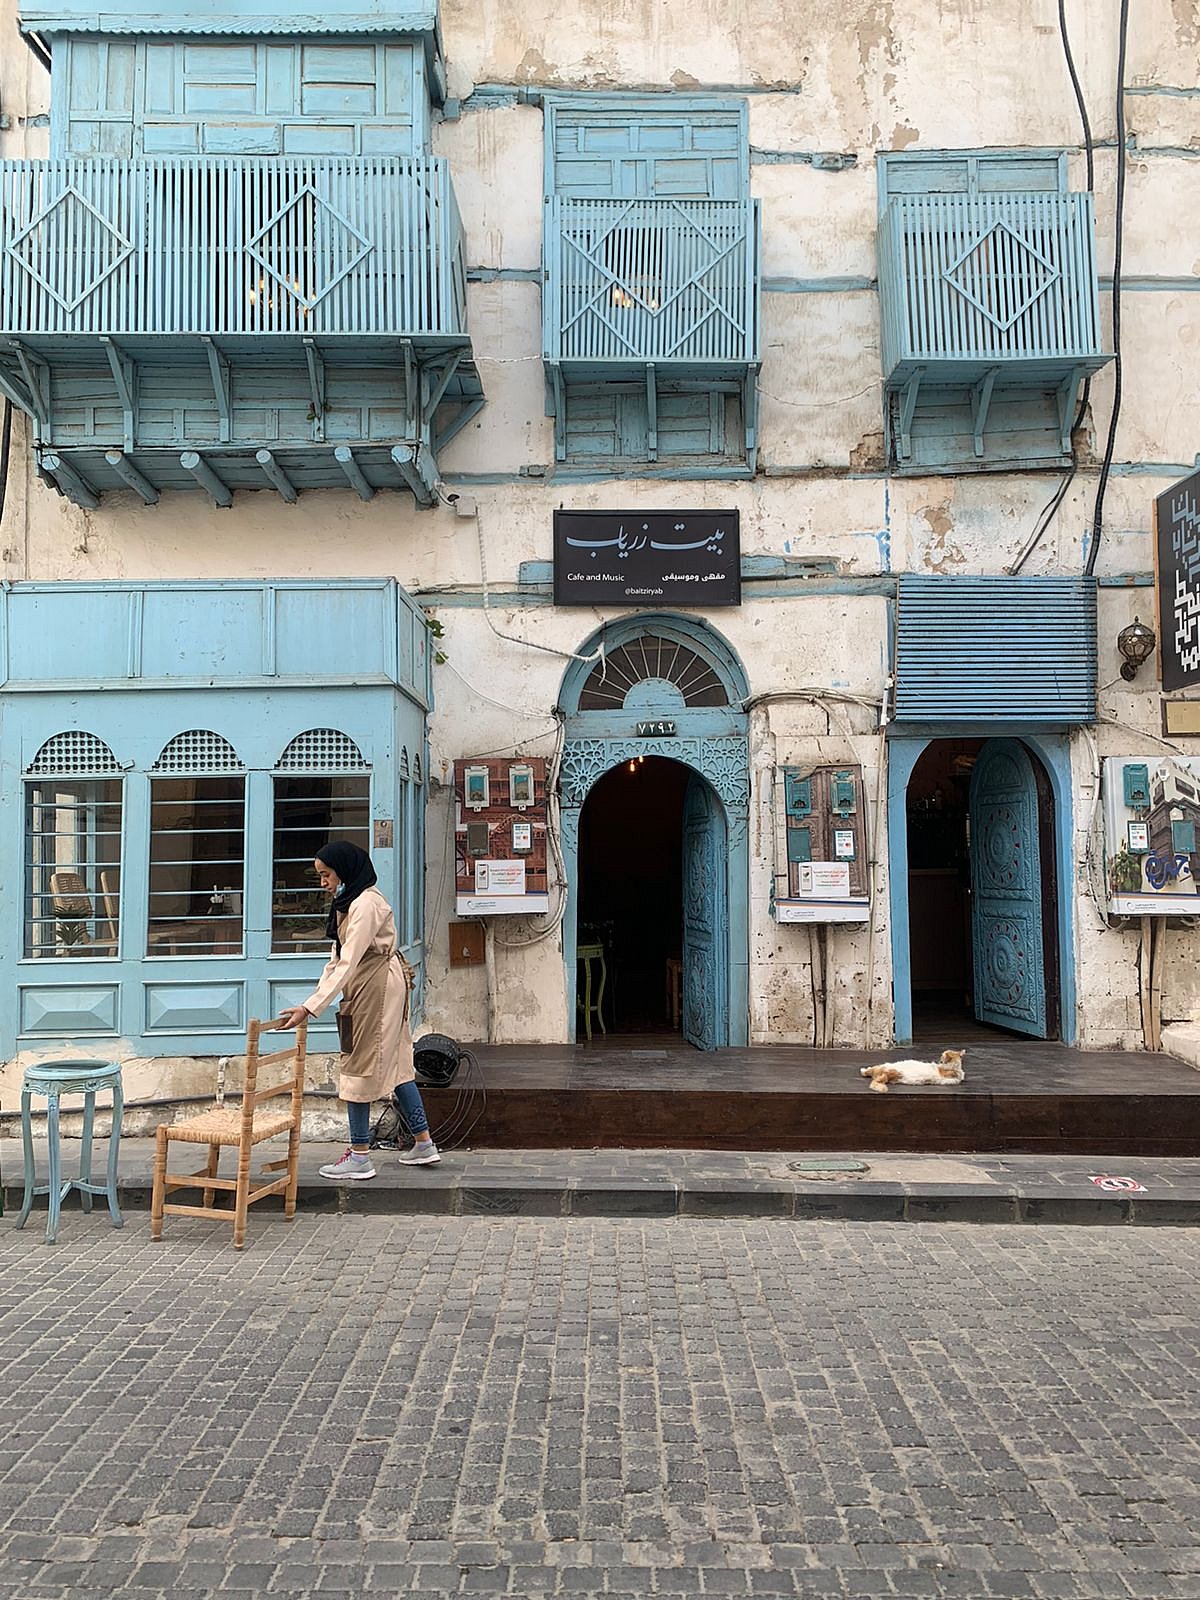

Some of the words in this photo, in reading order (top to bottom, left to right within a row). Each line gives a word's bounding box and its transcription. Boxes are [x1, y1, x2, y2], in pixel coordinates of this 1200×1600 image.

[566, 523, 648, 558] زرياب
[650, 523, 725, 555] بيت
[567, 573, 585, 581] Cafe
[586, 573, 601, 581] and
[602, 573, 625, 582] Music
[661, 573, 700, 582] وموسيقى
[701, 573, 726, 582] مقهى
[625, 587, 663, 595] @baitziryab
[638, 722, 674, 734] ٧٢٩٢
